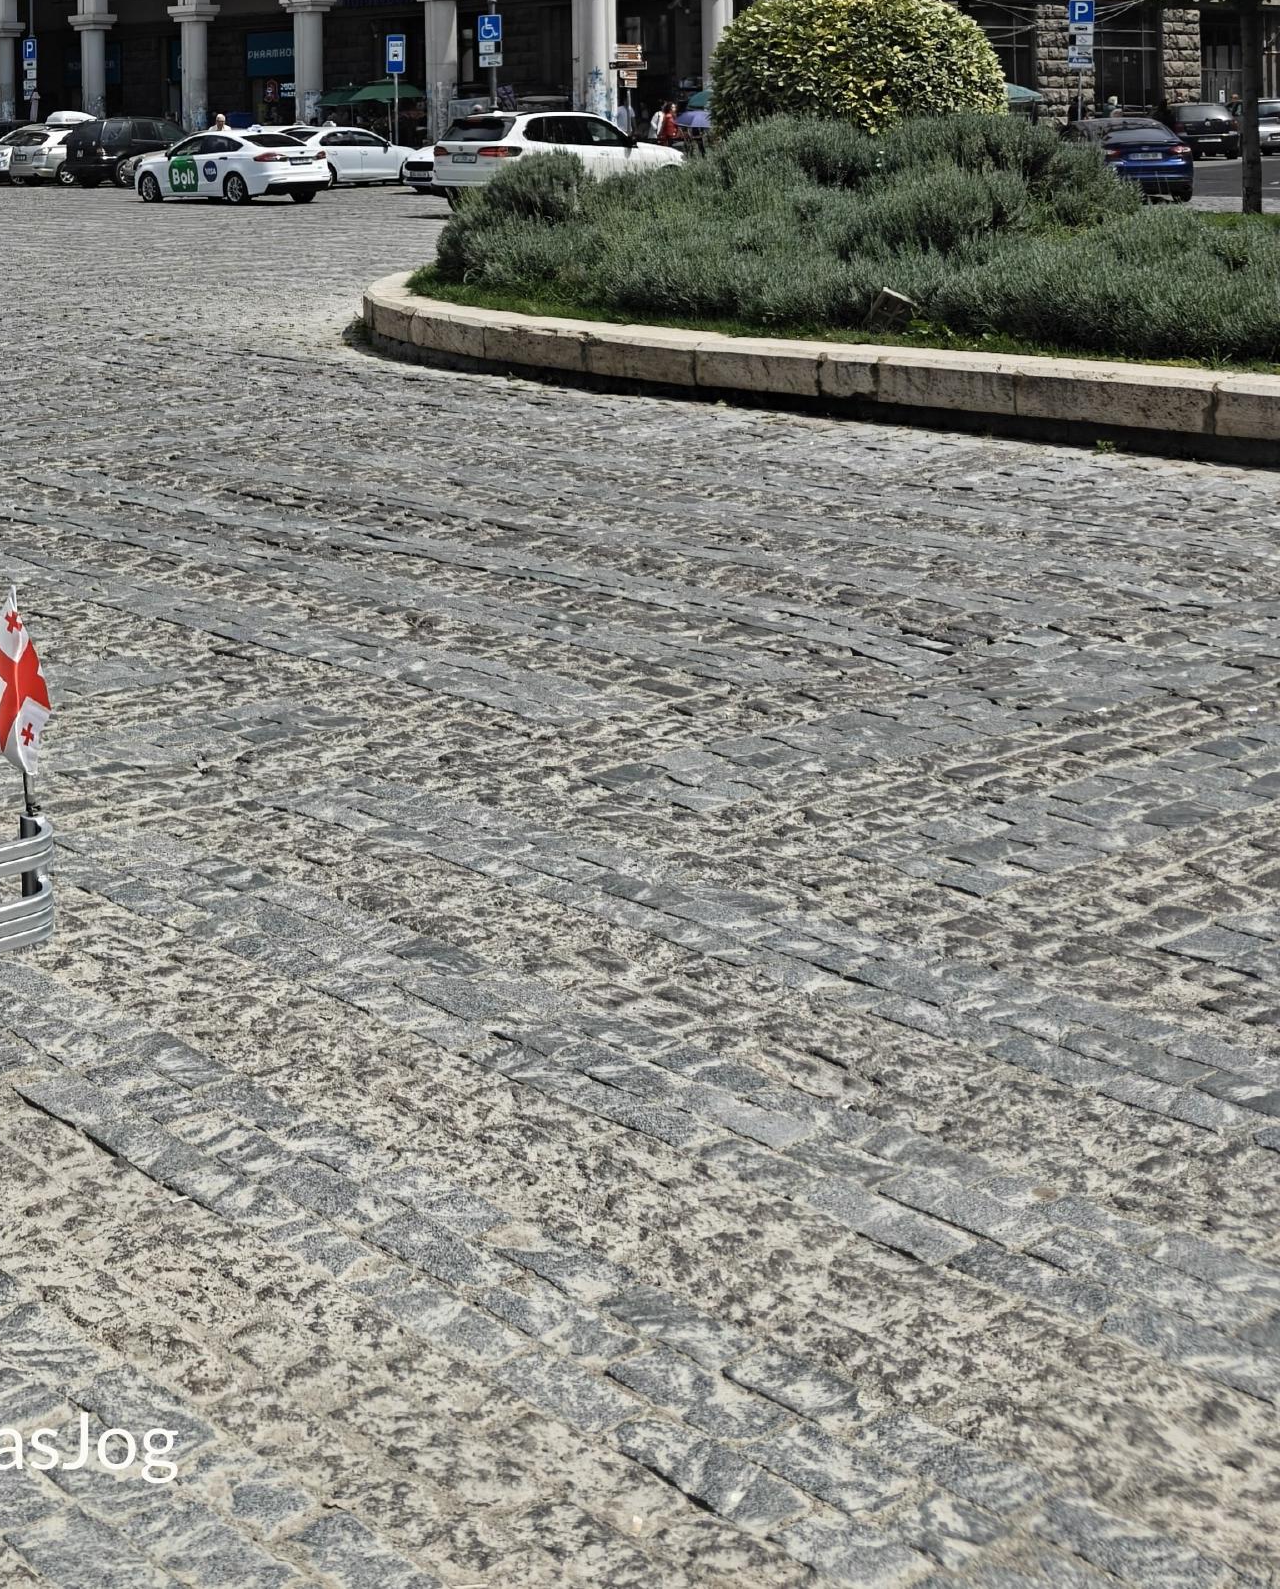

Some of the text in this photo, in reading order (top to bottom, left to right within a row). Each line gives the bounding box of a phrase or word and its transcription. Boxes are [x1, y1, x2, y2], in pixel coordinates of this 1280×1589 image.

[1075, 2, 1089, 20] P
[26, 41, 34, 58] P
[172, 168, 195, 188] Bolt
